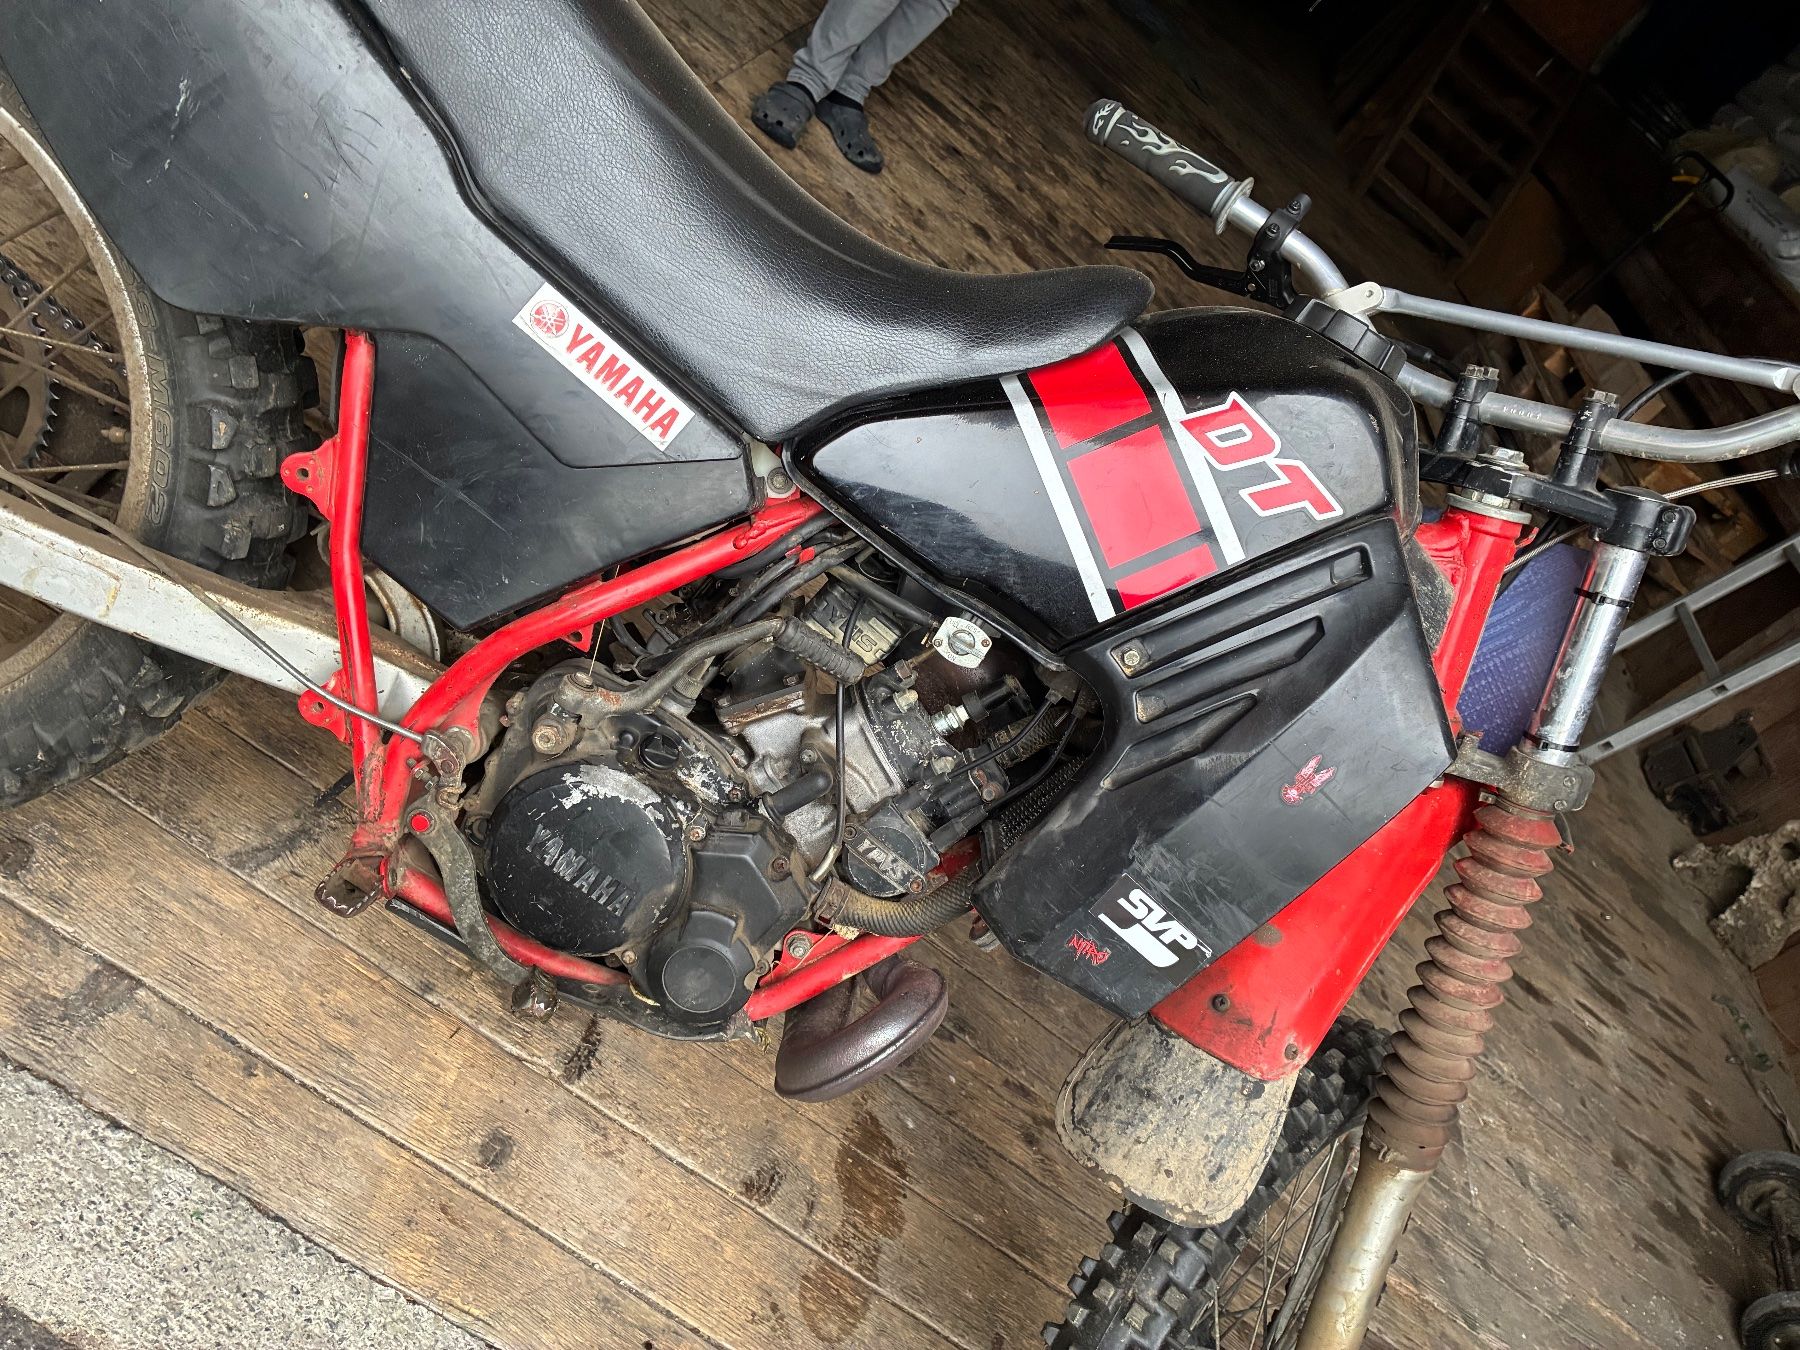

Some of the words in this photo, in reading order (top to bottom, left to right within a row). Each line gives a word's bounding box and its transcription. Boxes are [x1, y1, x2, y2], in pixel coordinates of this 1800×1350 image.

[565, 322, 680, 440] YAMAHA
[1178, 390, 1344, 521] DT
[525, 823, 638, 917] YAMAHA
[1116, 888, 1198, 950] SVP
